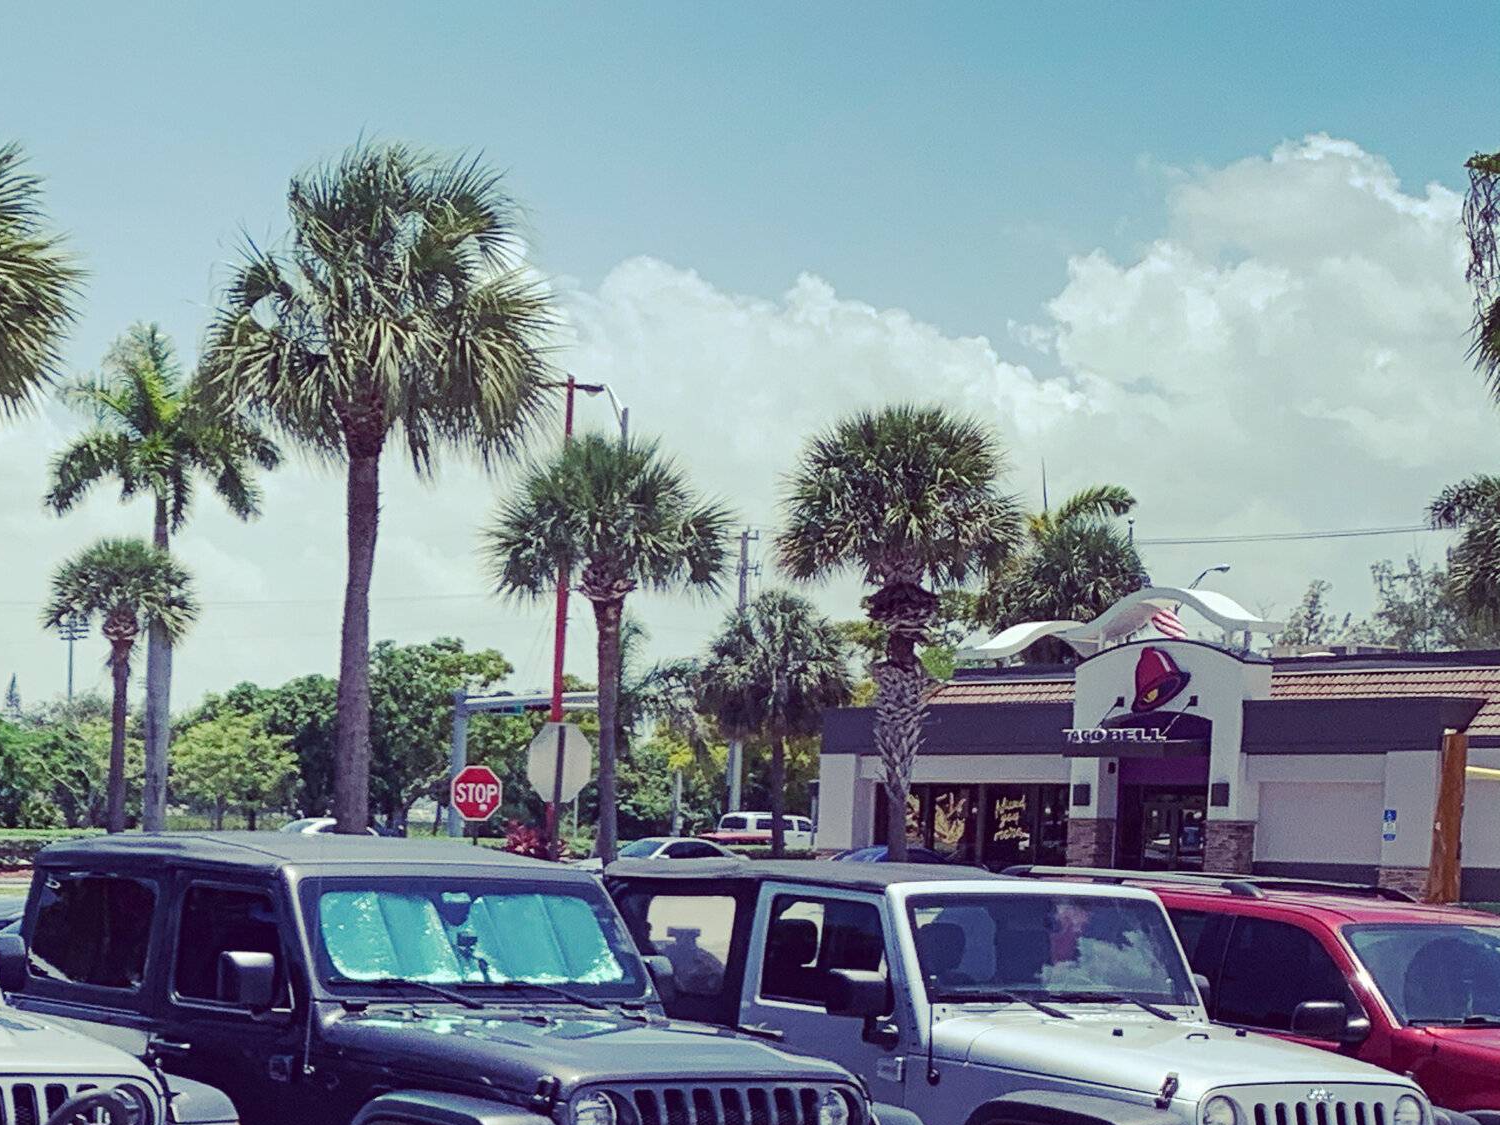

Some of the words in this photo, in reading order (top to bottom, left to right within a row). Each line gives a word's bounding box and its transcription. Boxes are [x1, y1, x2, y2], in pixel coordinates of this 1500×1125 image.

[1062, 728, 1107, 743] TACO
[1108, 728, 1167, 743] BELL
[455, 782, 498, 803] STOP
